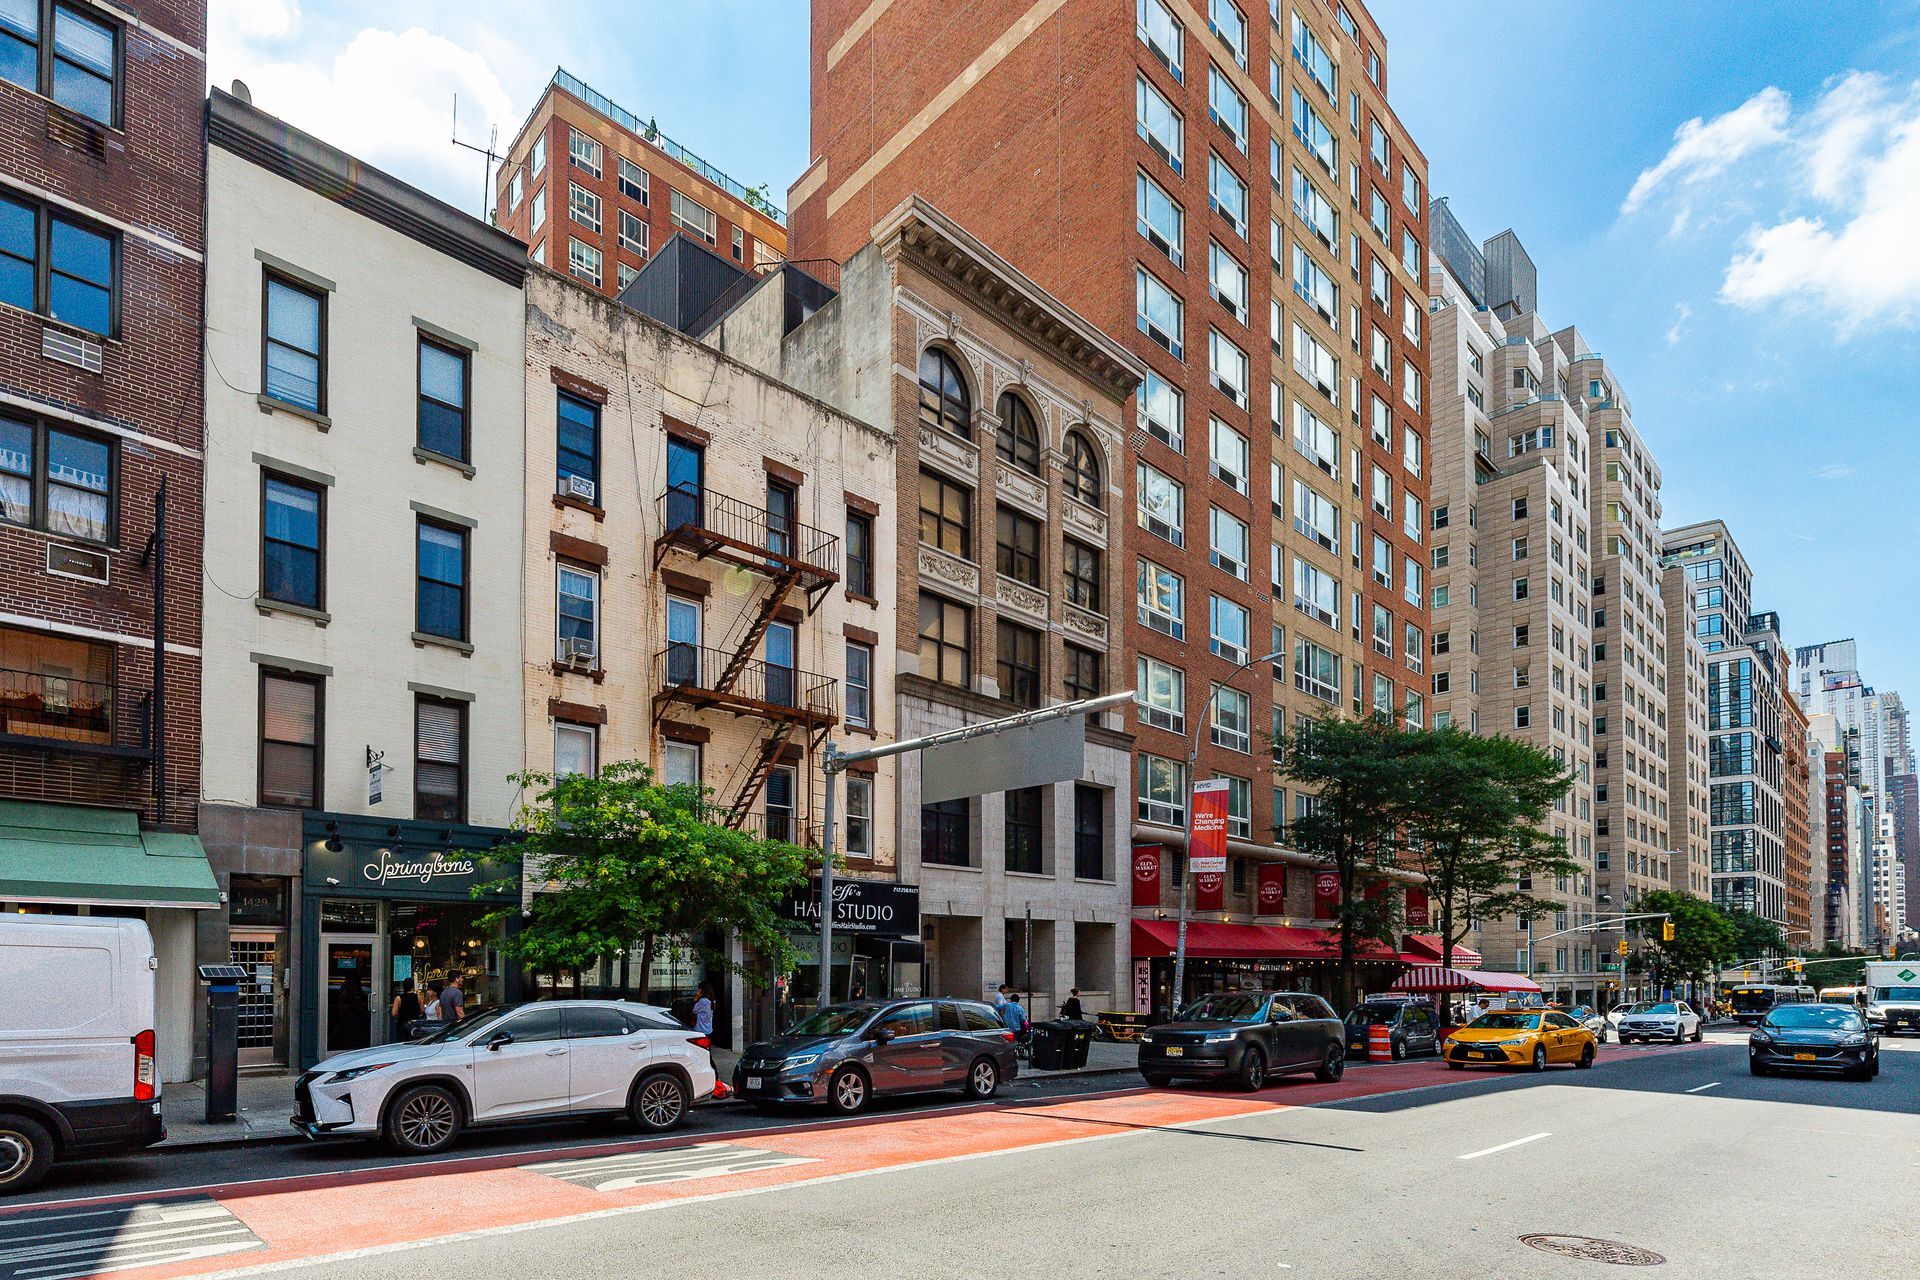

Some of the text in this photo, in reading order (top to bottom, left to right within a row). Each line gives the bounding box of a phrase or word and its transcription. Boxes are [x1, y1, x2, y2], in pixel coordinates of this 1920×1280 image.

[1194, 818, 1225, 826] Changing
[363, 851, 474, 886] Springbone
[832, 883, 862, 901] Effi's
[243, 897, 268, 907] 1429
[794, 901, 893, 920] HAI STUDIO
